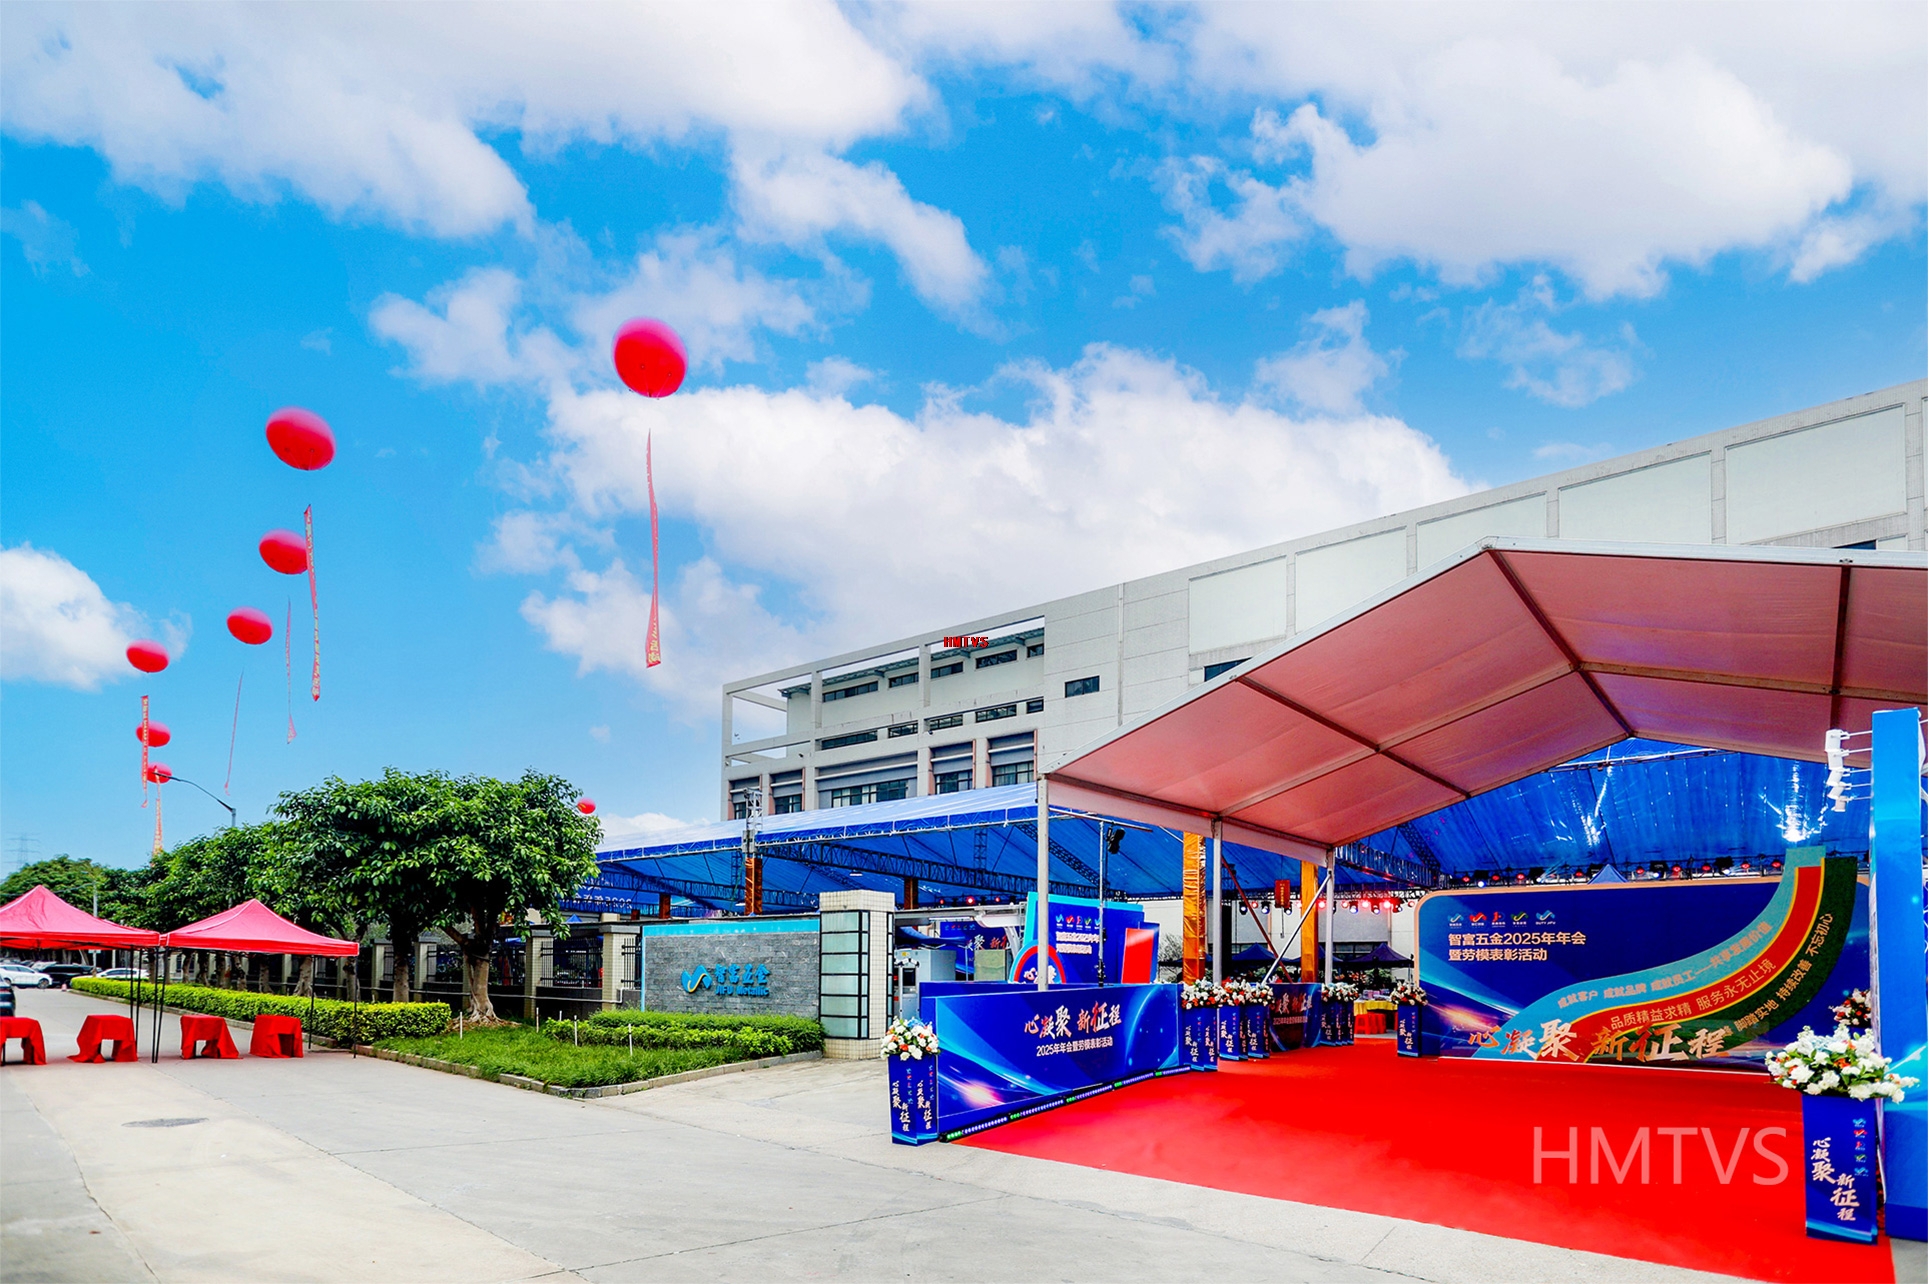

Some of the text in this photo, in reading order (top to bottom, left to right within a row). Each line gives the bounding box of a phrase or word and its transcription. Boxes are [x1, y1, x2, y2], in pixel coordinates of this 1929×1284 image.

[1448, 931, 1587, 946] 智富五金2025年年会
[1448, 948, 1548, 961] 暨劳模表彰活动
[714, 963, 771, 984] 智富五金
[715, 985, 734, 995] JIFU
[1734, 913, 1834, 1031] 脚踏实地 持续改善 不忘初心
[1610, 958, 1777, 1030] 品质精益求精 服务永无止境
[1024, 1000, 1122, 1039] 心凝聚 新征程
[1468, 1019, 1731, 1062] 心凝聚 新征程
[1811, 1137, 1836, 1184] 心凝聚
[1830, 1172, 1860, 1221] 新征程
